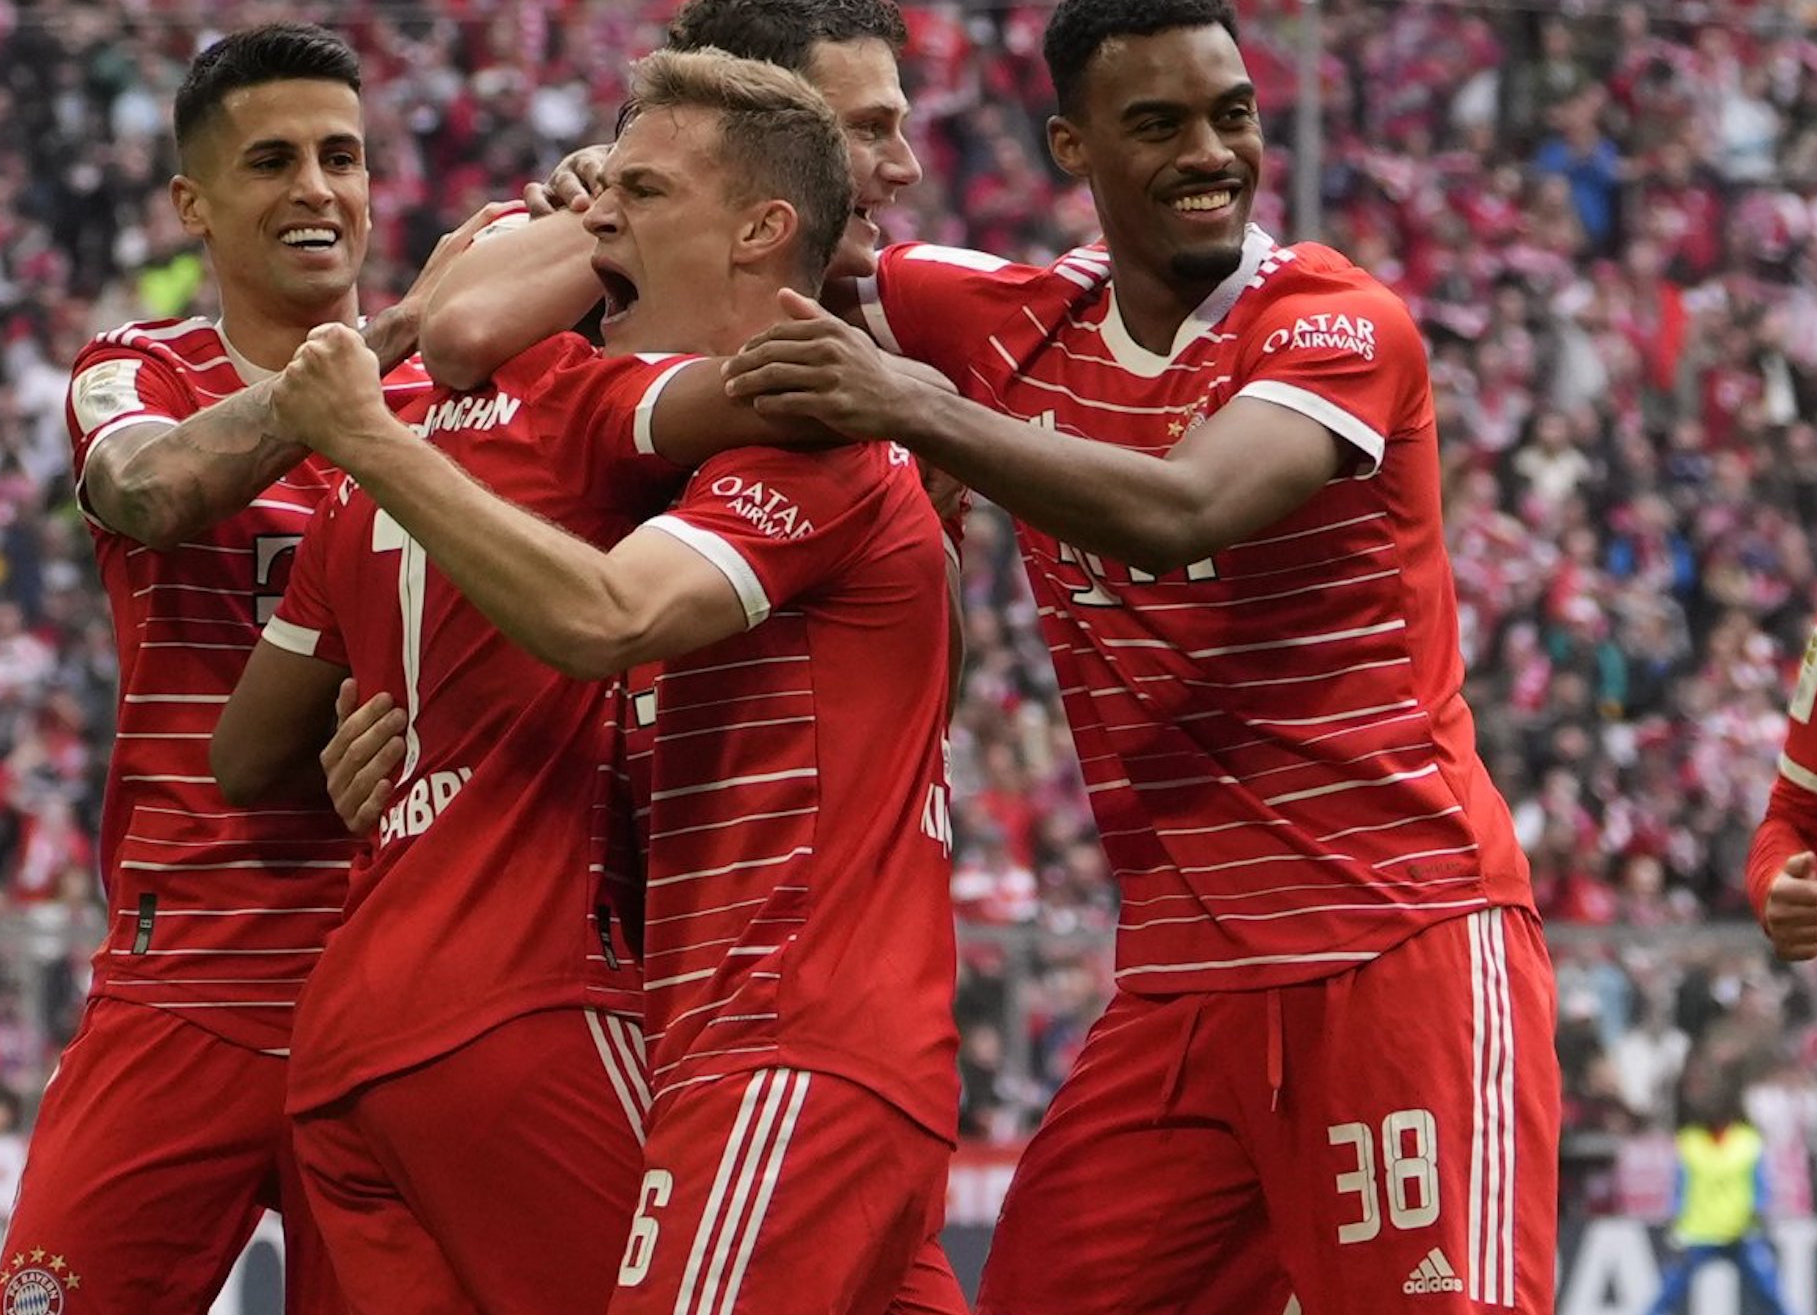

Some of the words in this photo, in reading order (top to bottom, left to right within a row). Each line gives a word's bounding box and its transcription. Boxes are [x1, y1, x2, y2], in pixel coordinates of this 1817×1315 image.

[1262, 313, 1376, 354] QATAR
[1288, 331, 1376, 362] AIRWAYS
[1327, 1108, 1441, 1246] 38
[617, 1168, 674, 1287] 6
[21, 1272, 59, 1300] BAYERN
[1403, 1278, 1464, 1295] adidas
